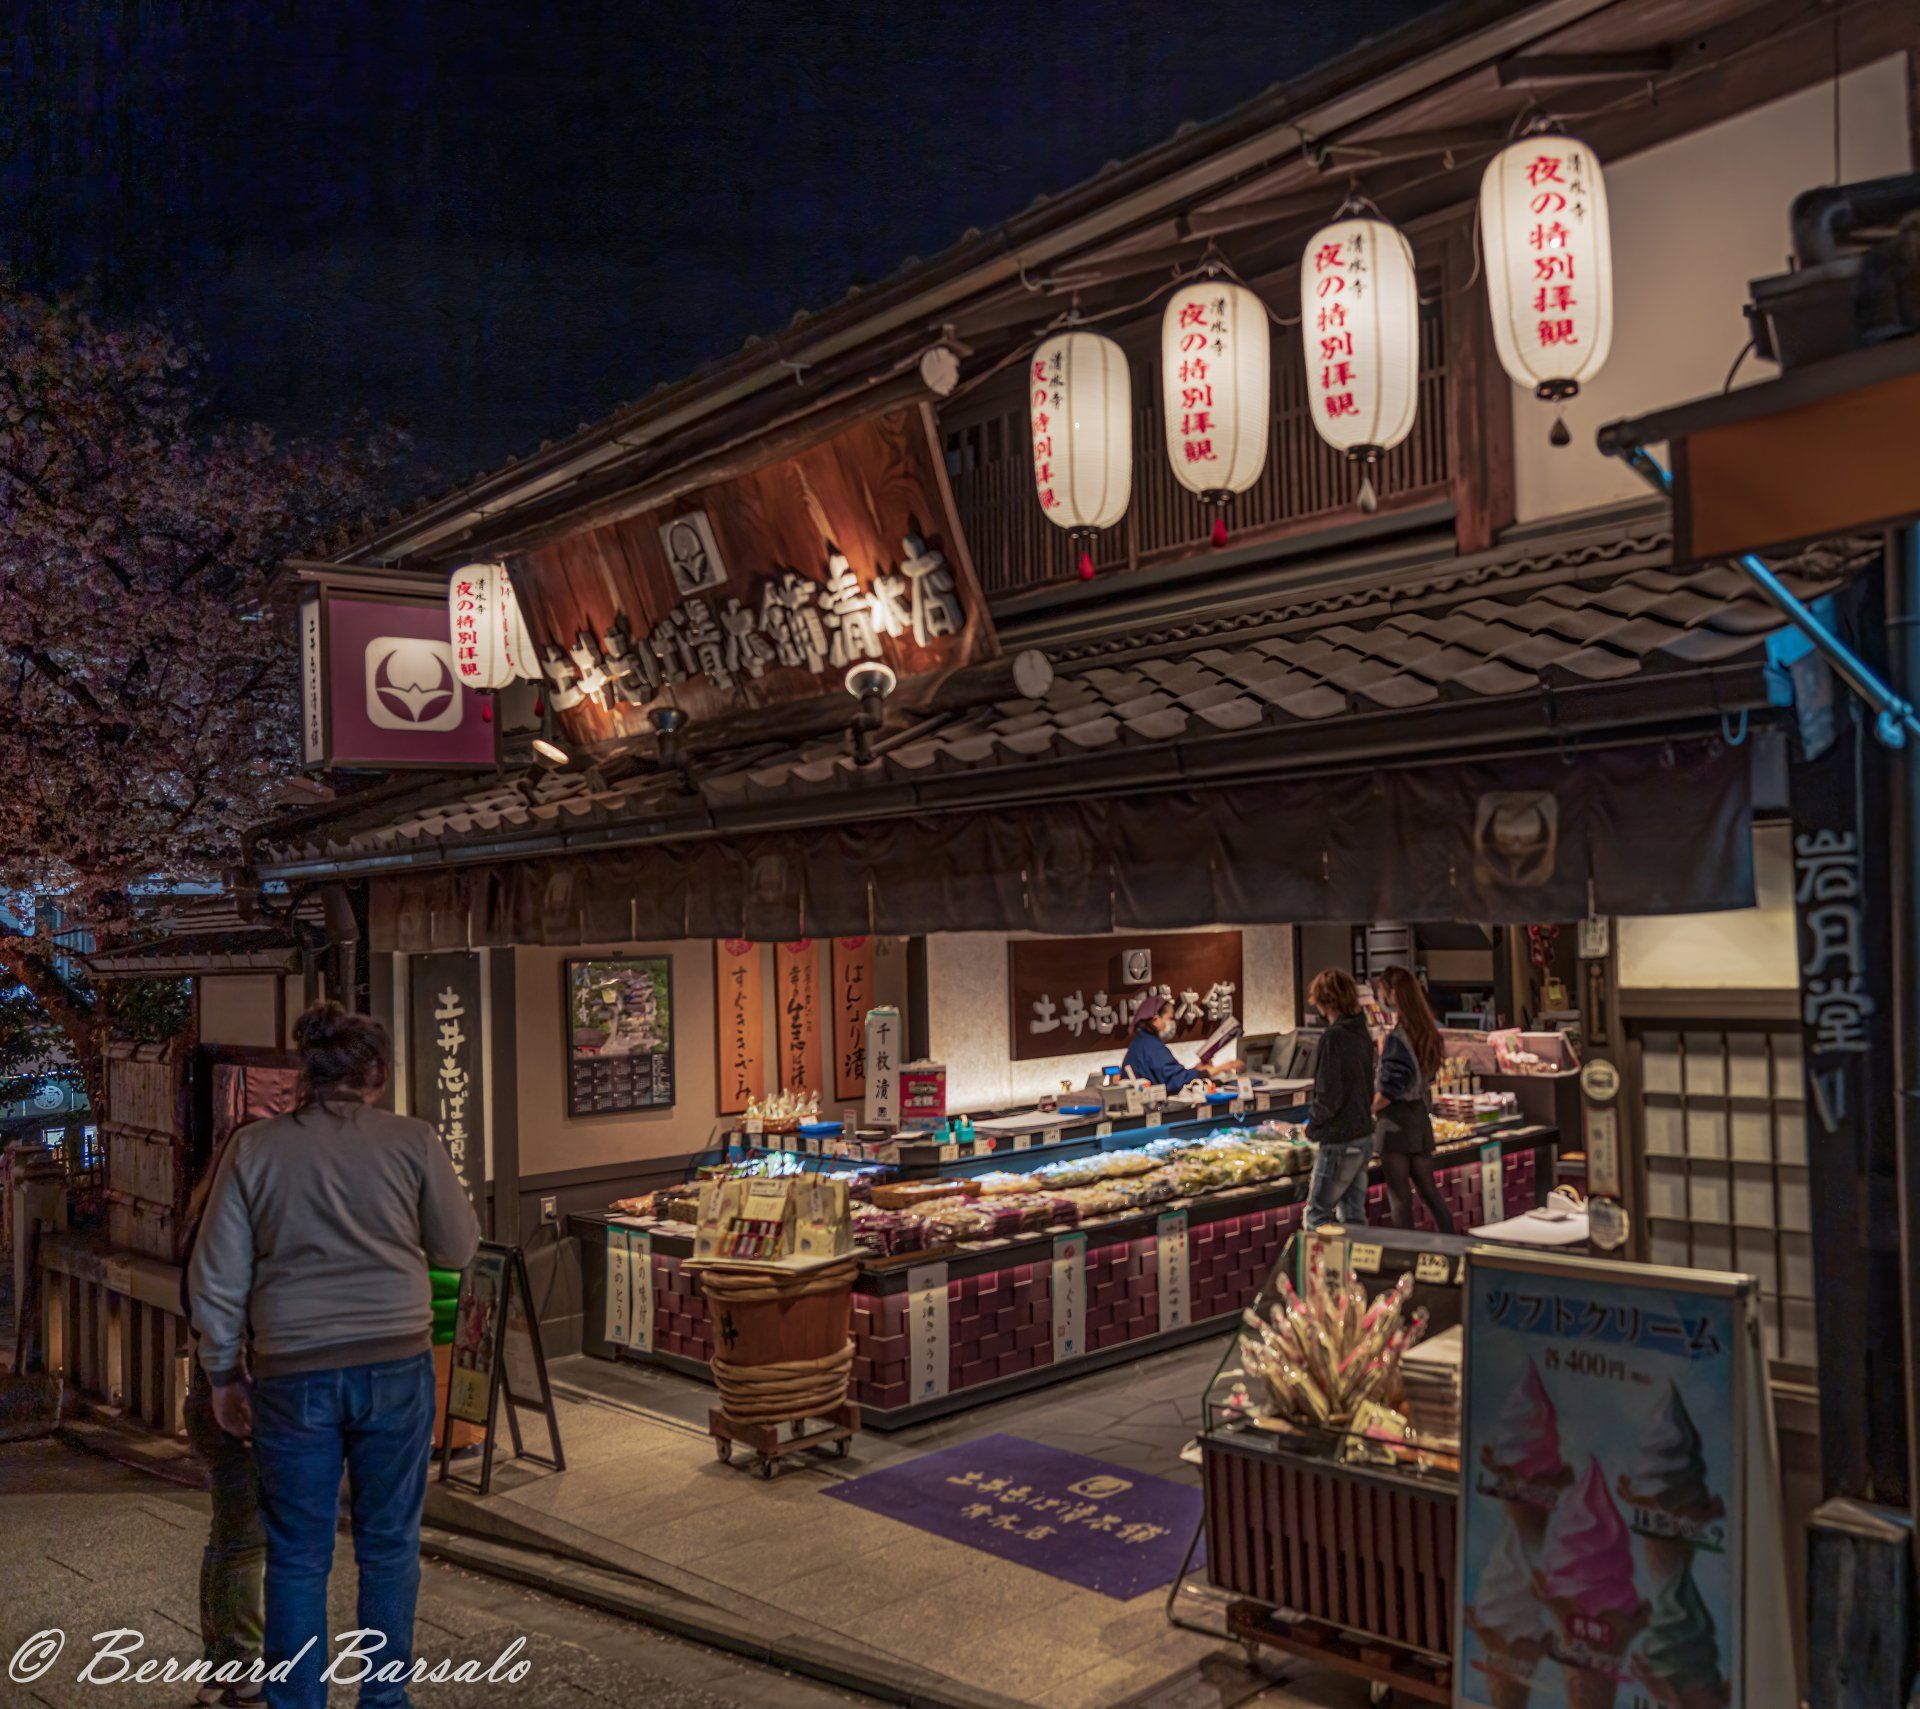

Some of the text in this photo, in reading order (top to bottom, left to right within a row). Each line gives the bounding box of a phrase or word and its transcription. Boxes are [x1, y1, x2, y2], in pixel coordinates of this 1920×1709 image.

[1314, 243, 1360, 420] 夜の特別拝観
[1524, 156, 1579, 348] 夜の特別拝観
[1178, 303, 1218, 464] 夜の特別拝観
[435, 986, 472, 1201] 土井志ば漬
[875, 1022, 891, 1100] 千枚漬
[1486, 1291, 1723, 1355] ソフトクリーム
